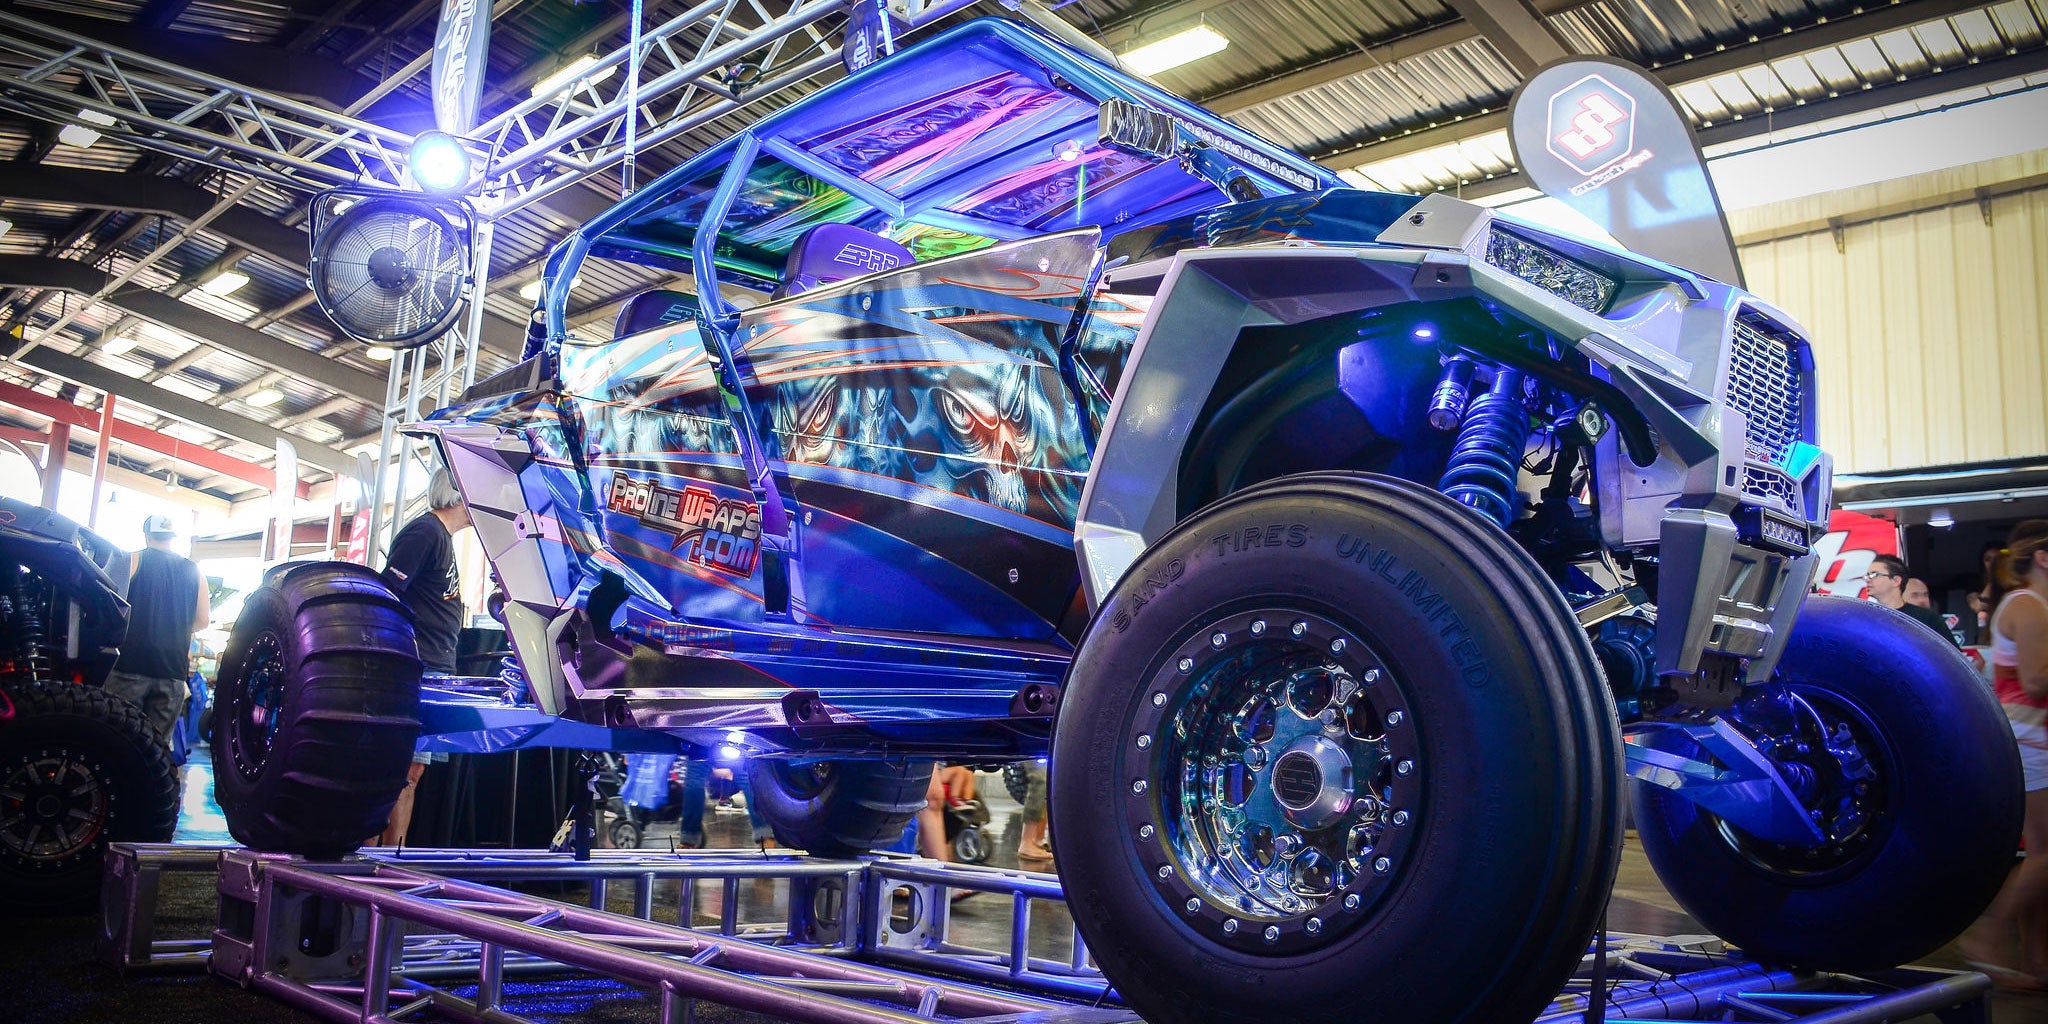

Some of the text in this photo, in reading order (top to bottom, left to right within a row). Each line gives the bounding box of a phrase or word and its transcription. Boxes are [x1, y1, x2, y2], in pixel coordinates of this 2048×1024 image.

[833, 243, 900, 272] PRP
[681, 493, 761, 540] WRAPS
[1112, 523, 1491, 689] SAND TIRES UNLIMITED
